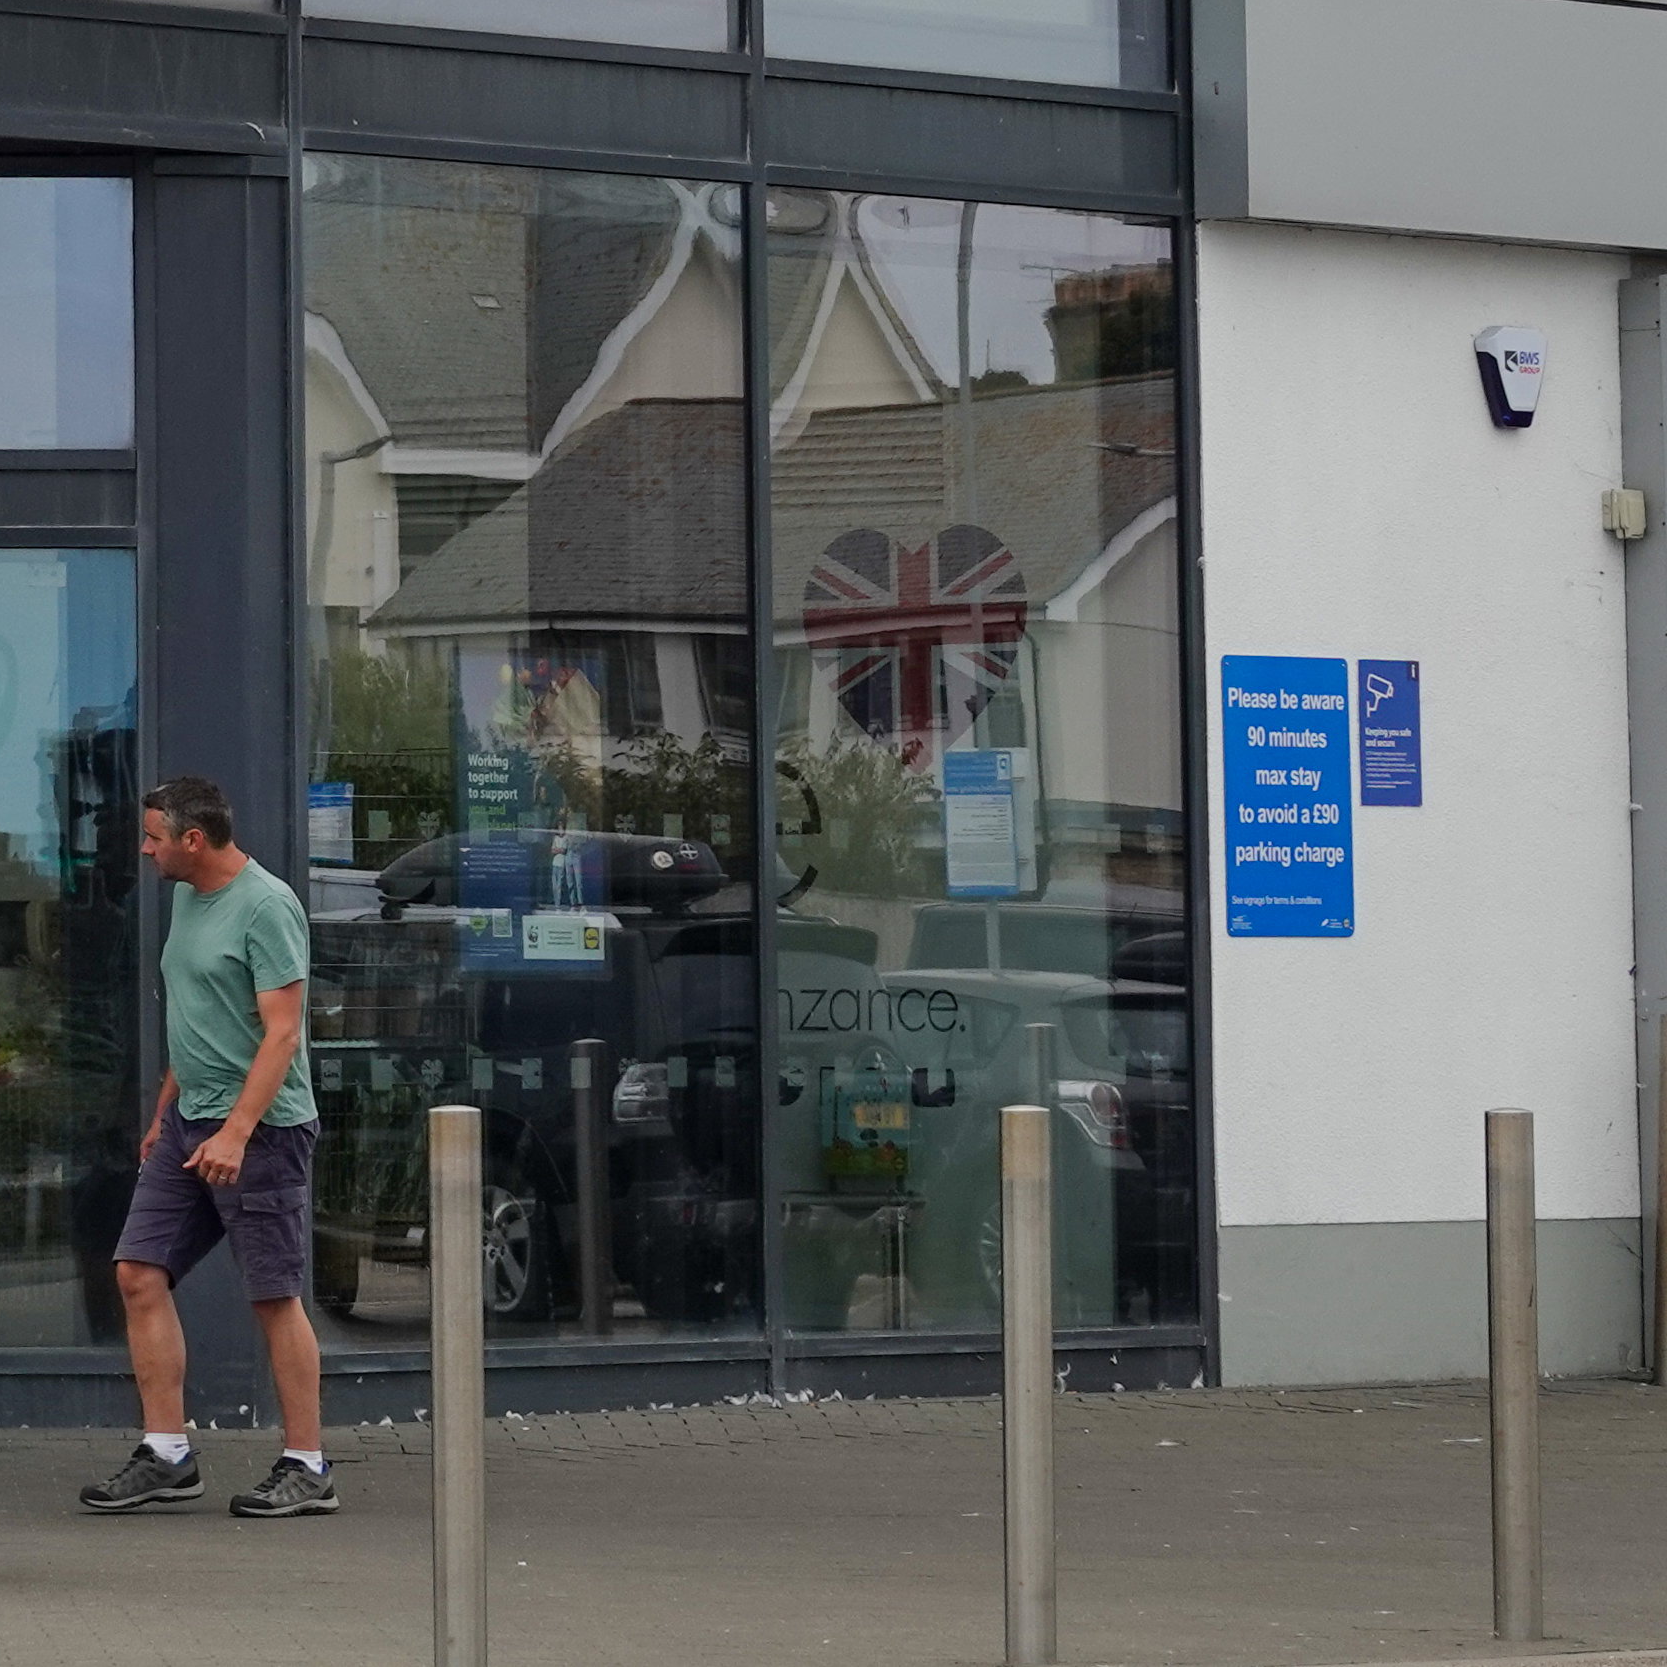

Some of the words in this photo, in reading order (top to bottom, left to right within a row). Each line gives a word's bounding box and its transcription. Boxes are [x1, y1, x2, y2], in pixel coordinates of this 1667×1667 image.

[1519, 351, 1540, 365] BWS
[1228, 687, 1277, 709] Please
[1280, 689, 1298, 709] be
[1302, 695, 1345, 710] aware
[1247, 726, 1265, 746] 90
[1269, 727, 1327, 748] minutes
[468, 754, 509, 770] Working
[468, 771, 509, 785] together
[1256, 769, 1287, 785] max
[1290, 767, 1322, 791] stay
[468, 788, 479, 798] to
[480, 789, 518, 802] support
[1239, 803, 1254, 823] to
[1257, 803, 1298, 824] avoid
[1301, 808, 1310, 824] a
[1313, 803, 1339, 824] £90
[1236, 841, 1291, 867] parking
[1294, 842, 1344, 867] charge
